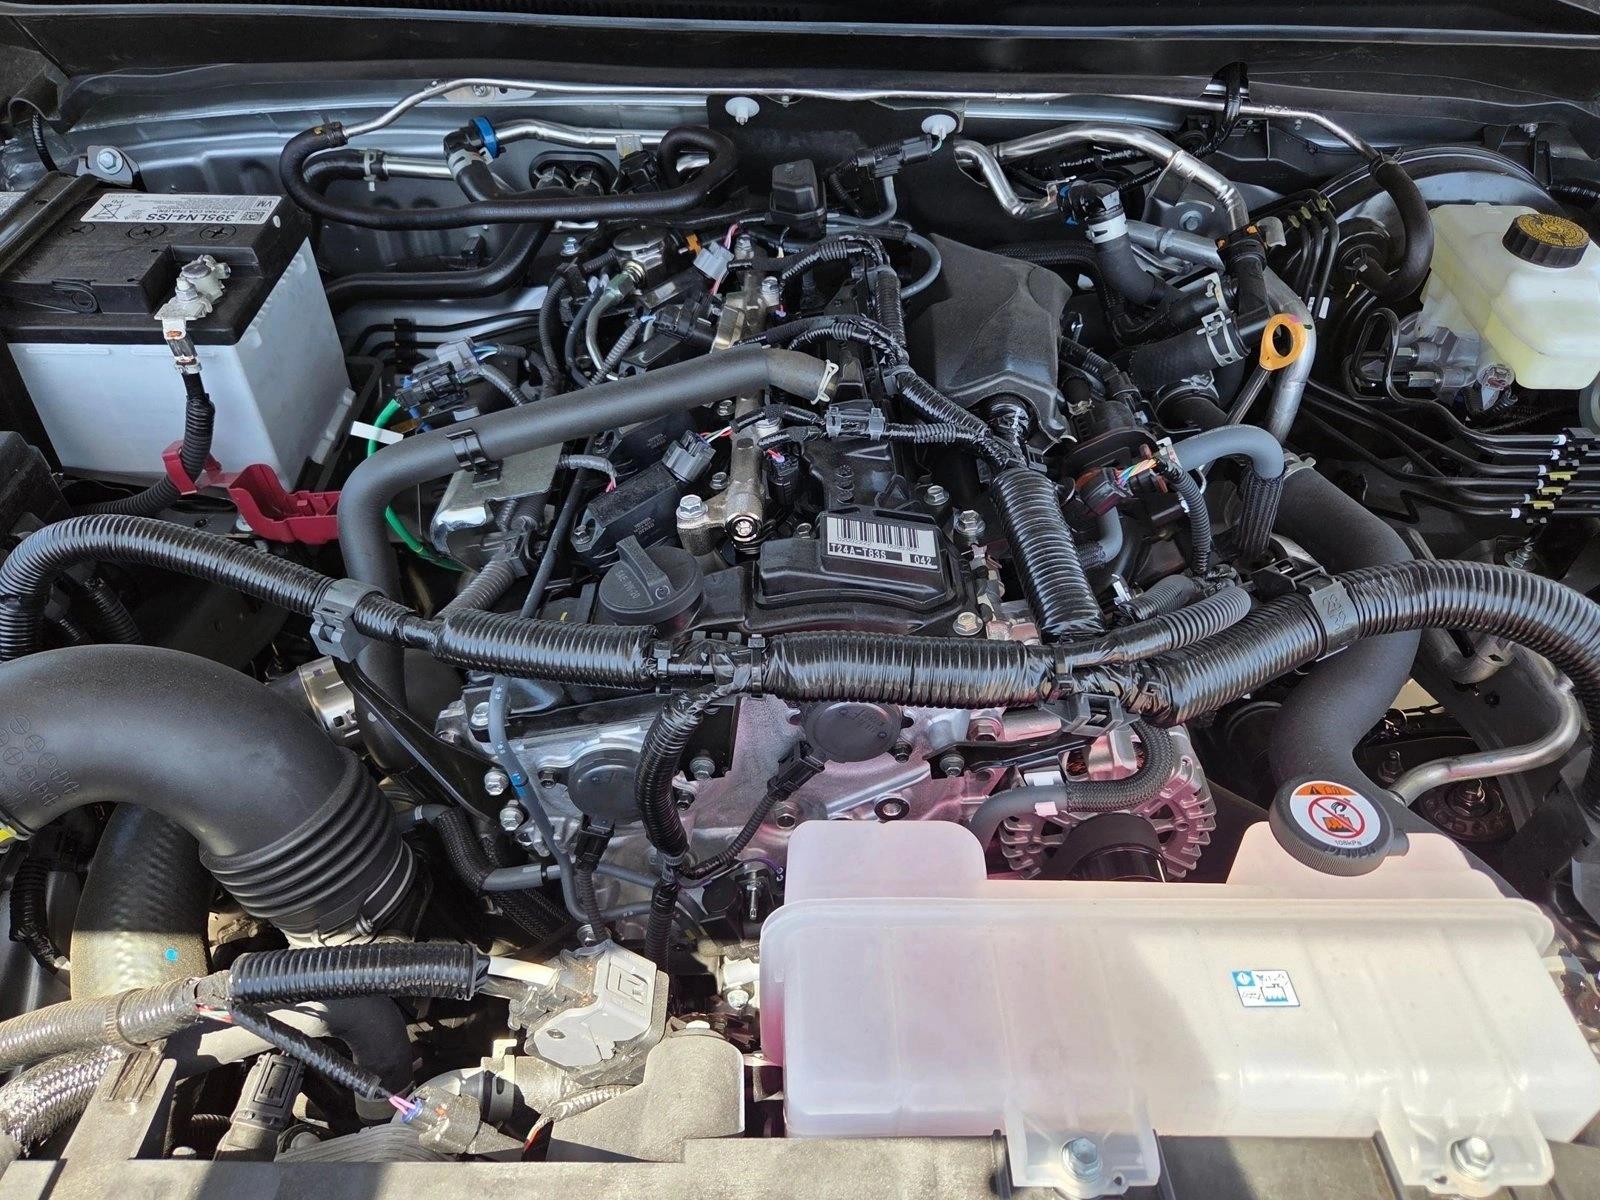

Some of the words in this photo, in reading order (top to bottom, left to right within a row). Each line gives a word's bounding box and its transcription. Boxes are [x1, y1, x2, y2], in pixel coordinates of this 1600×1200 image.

[256, 200, 272, 208] VM
[145, 213, 234, 222] 395LN4-ISS
[914, 555, 932, 566] 042
